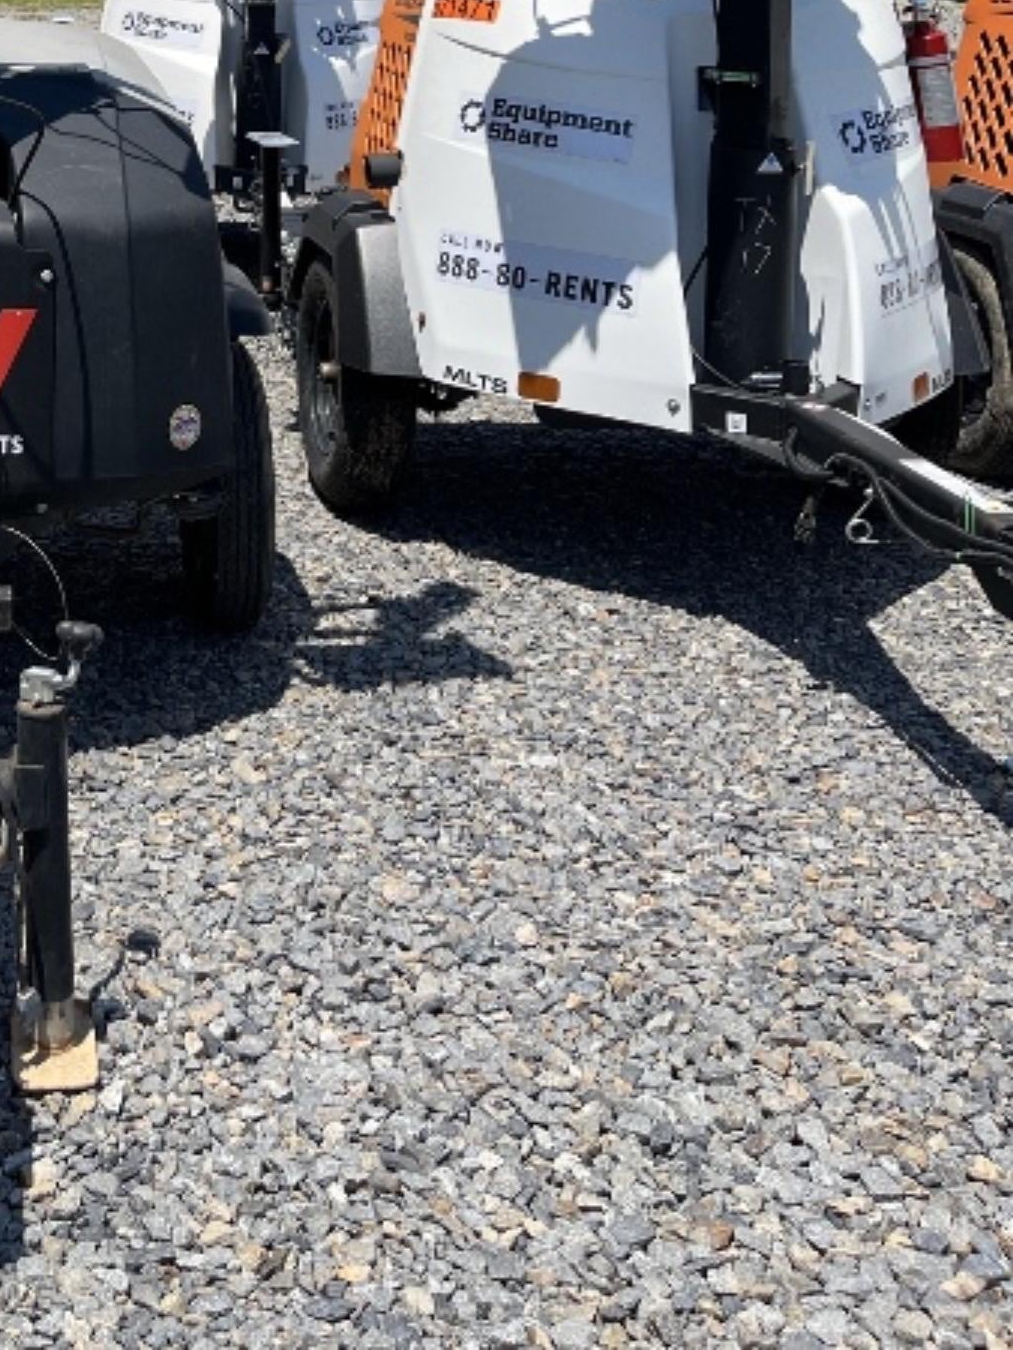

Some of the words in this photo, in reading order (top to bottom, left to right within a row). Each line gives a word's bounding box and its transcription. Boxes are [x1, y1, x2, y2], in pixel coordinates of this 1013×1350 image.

[488, 123, 559, 148] Share
[492, 98, 634, 139] Equipment
[438, 251, 634, 309] 888-80-RENTS
[443, 365, 508, 394] MLTS
